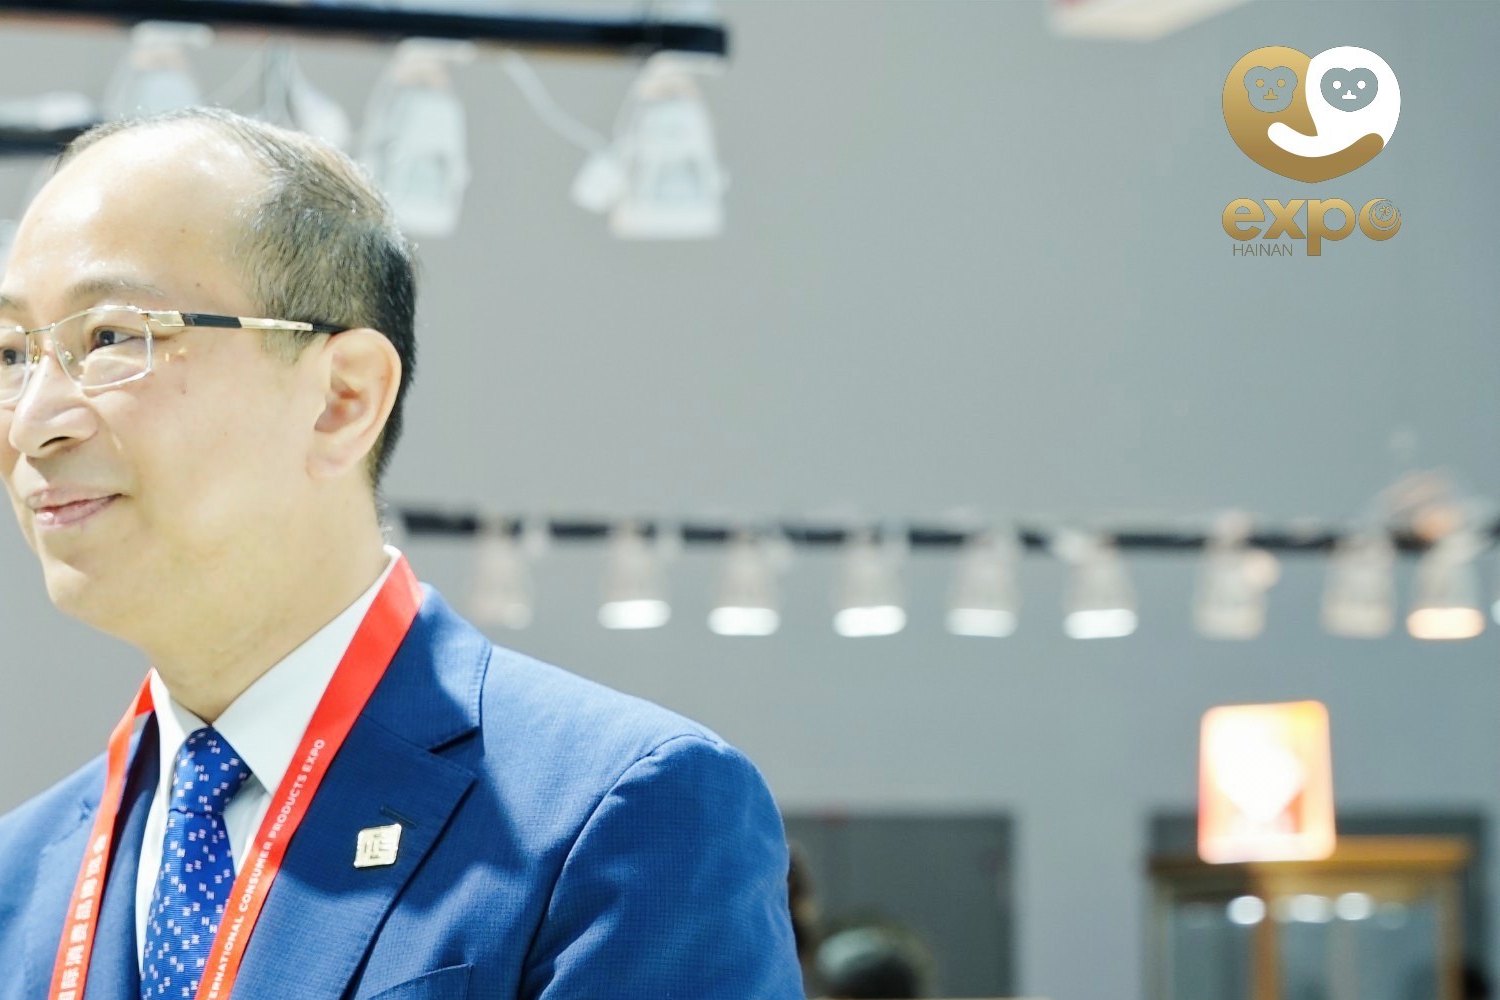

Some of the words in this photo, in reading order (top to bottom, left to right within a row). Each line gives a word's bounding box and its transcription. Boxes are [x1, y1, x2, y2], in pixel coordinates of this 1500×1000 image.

[238, 841, 274, 913] CONSUMER
[267, 773, 308, 840] PRODUCTS
[301, 738, 326, 773] EXPO
